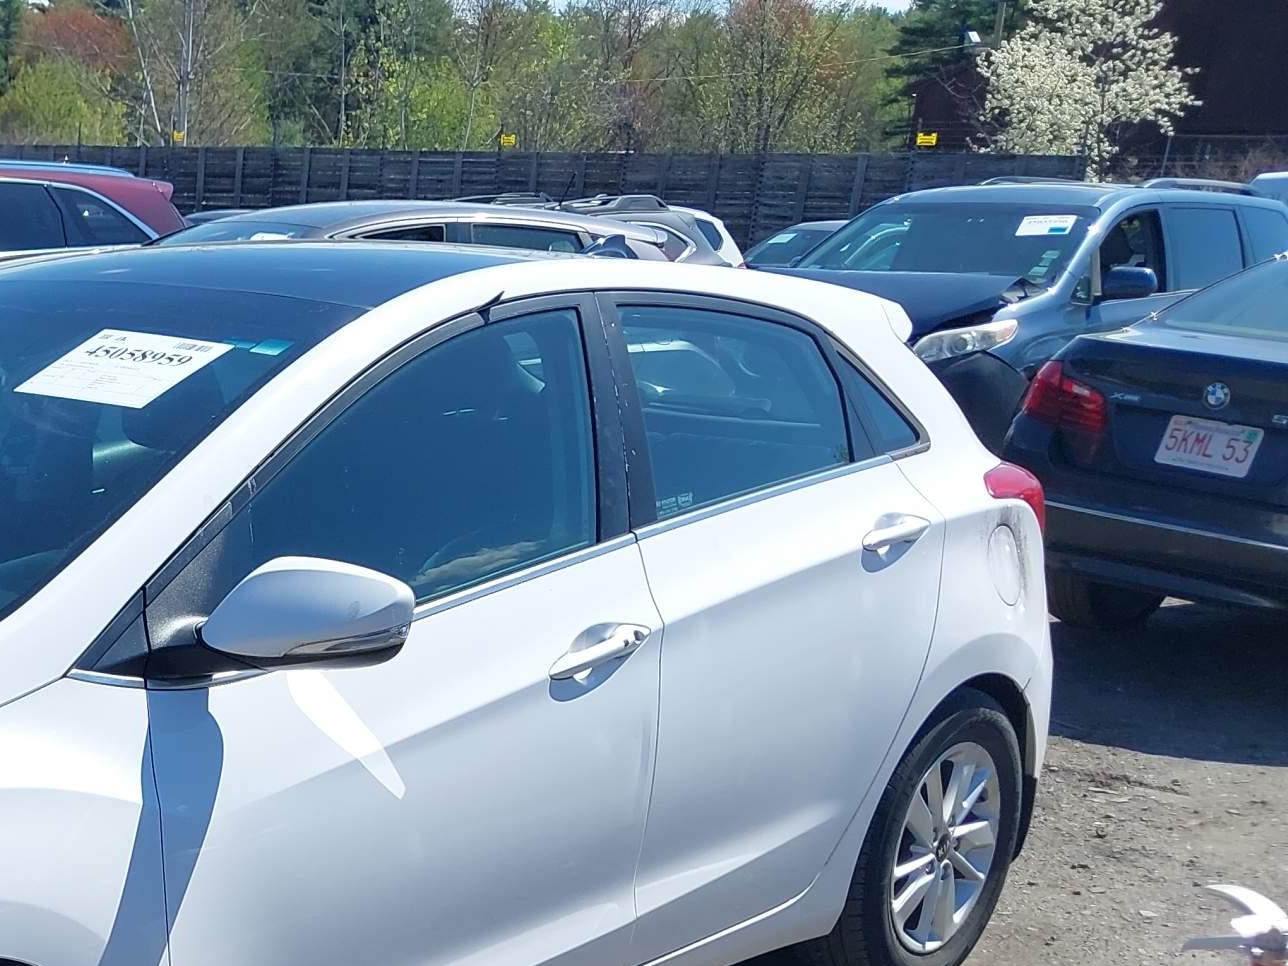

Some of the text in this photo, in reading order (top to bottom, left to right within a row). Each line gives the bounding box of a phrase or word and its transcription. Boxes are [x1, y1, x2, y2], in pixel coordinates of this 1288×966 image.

[85, 344, 193, 366] 45058959
[1164, 427, 1254, 464] 5KML 53
